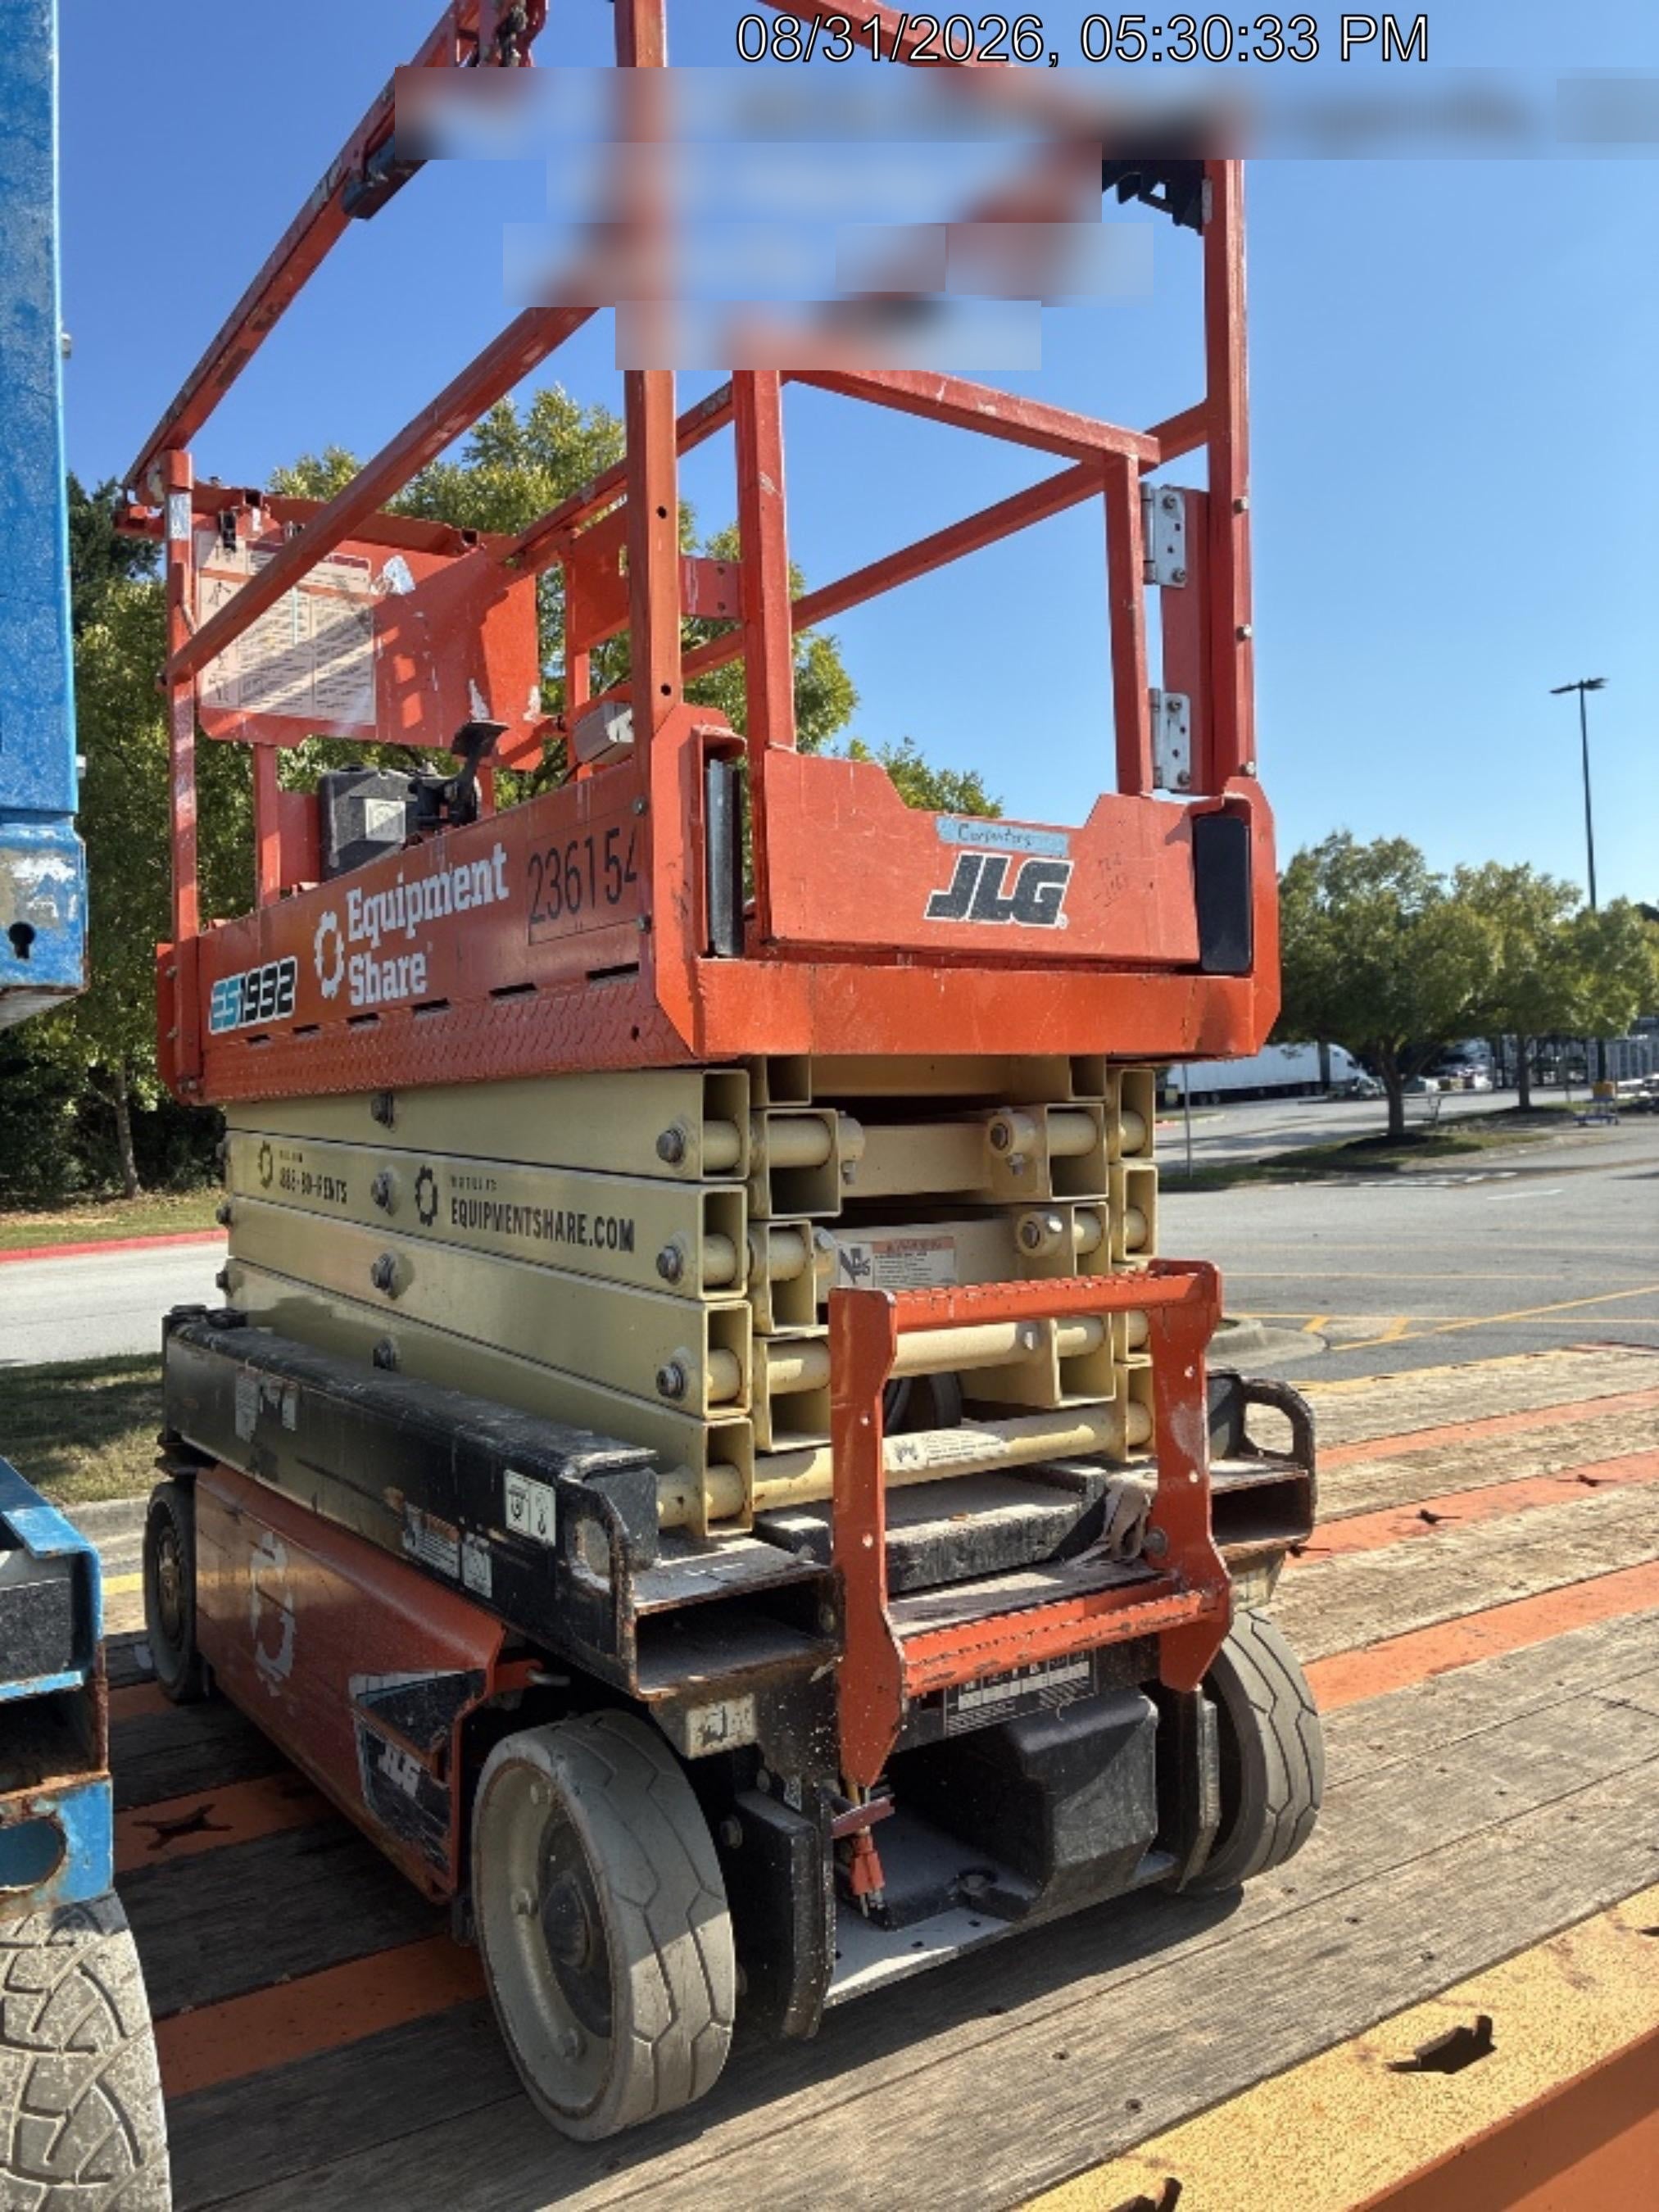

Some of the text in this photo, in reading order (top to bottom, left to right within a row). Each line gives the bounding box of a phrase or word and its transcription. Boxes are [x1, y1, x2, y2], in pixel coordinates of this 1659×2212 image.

[346, 842, 510, 949] Equipment
[923, 850, 1075, 929] JLG
[208, 955, 298, 1036] ES1932
[348, 950, 428, 1006] Share
[451, 1196, 635, 1253] EQUIPMENTSHARE.COM
